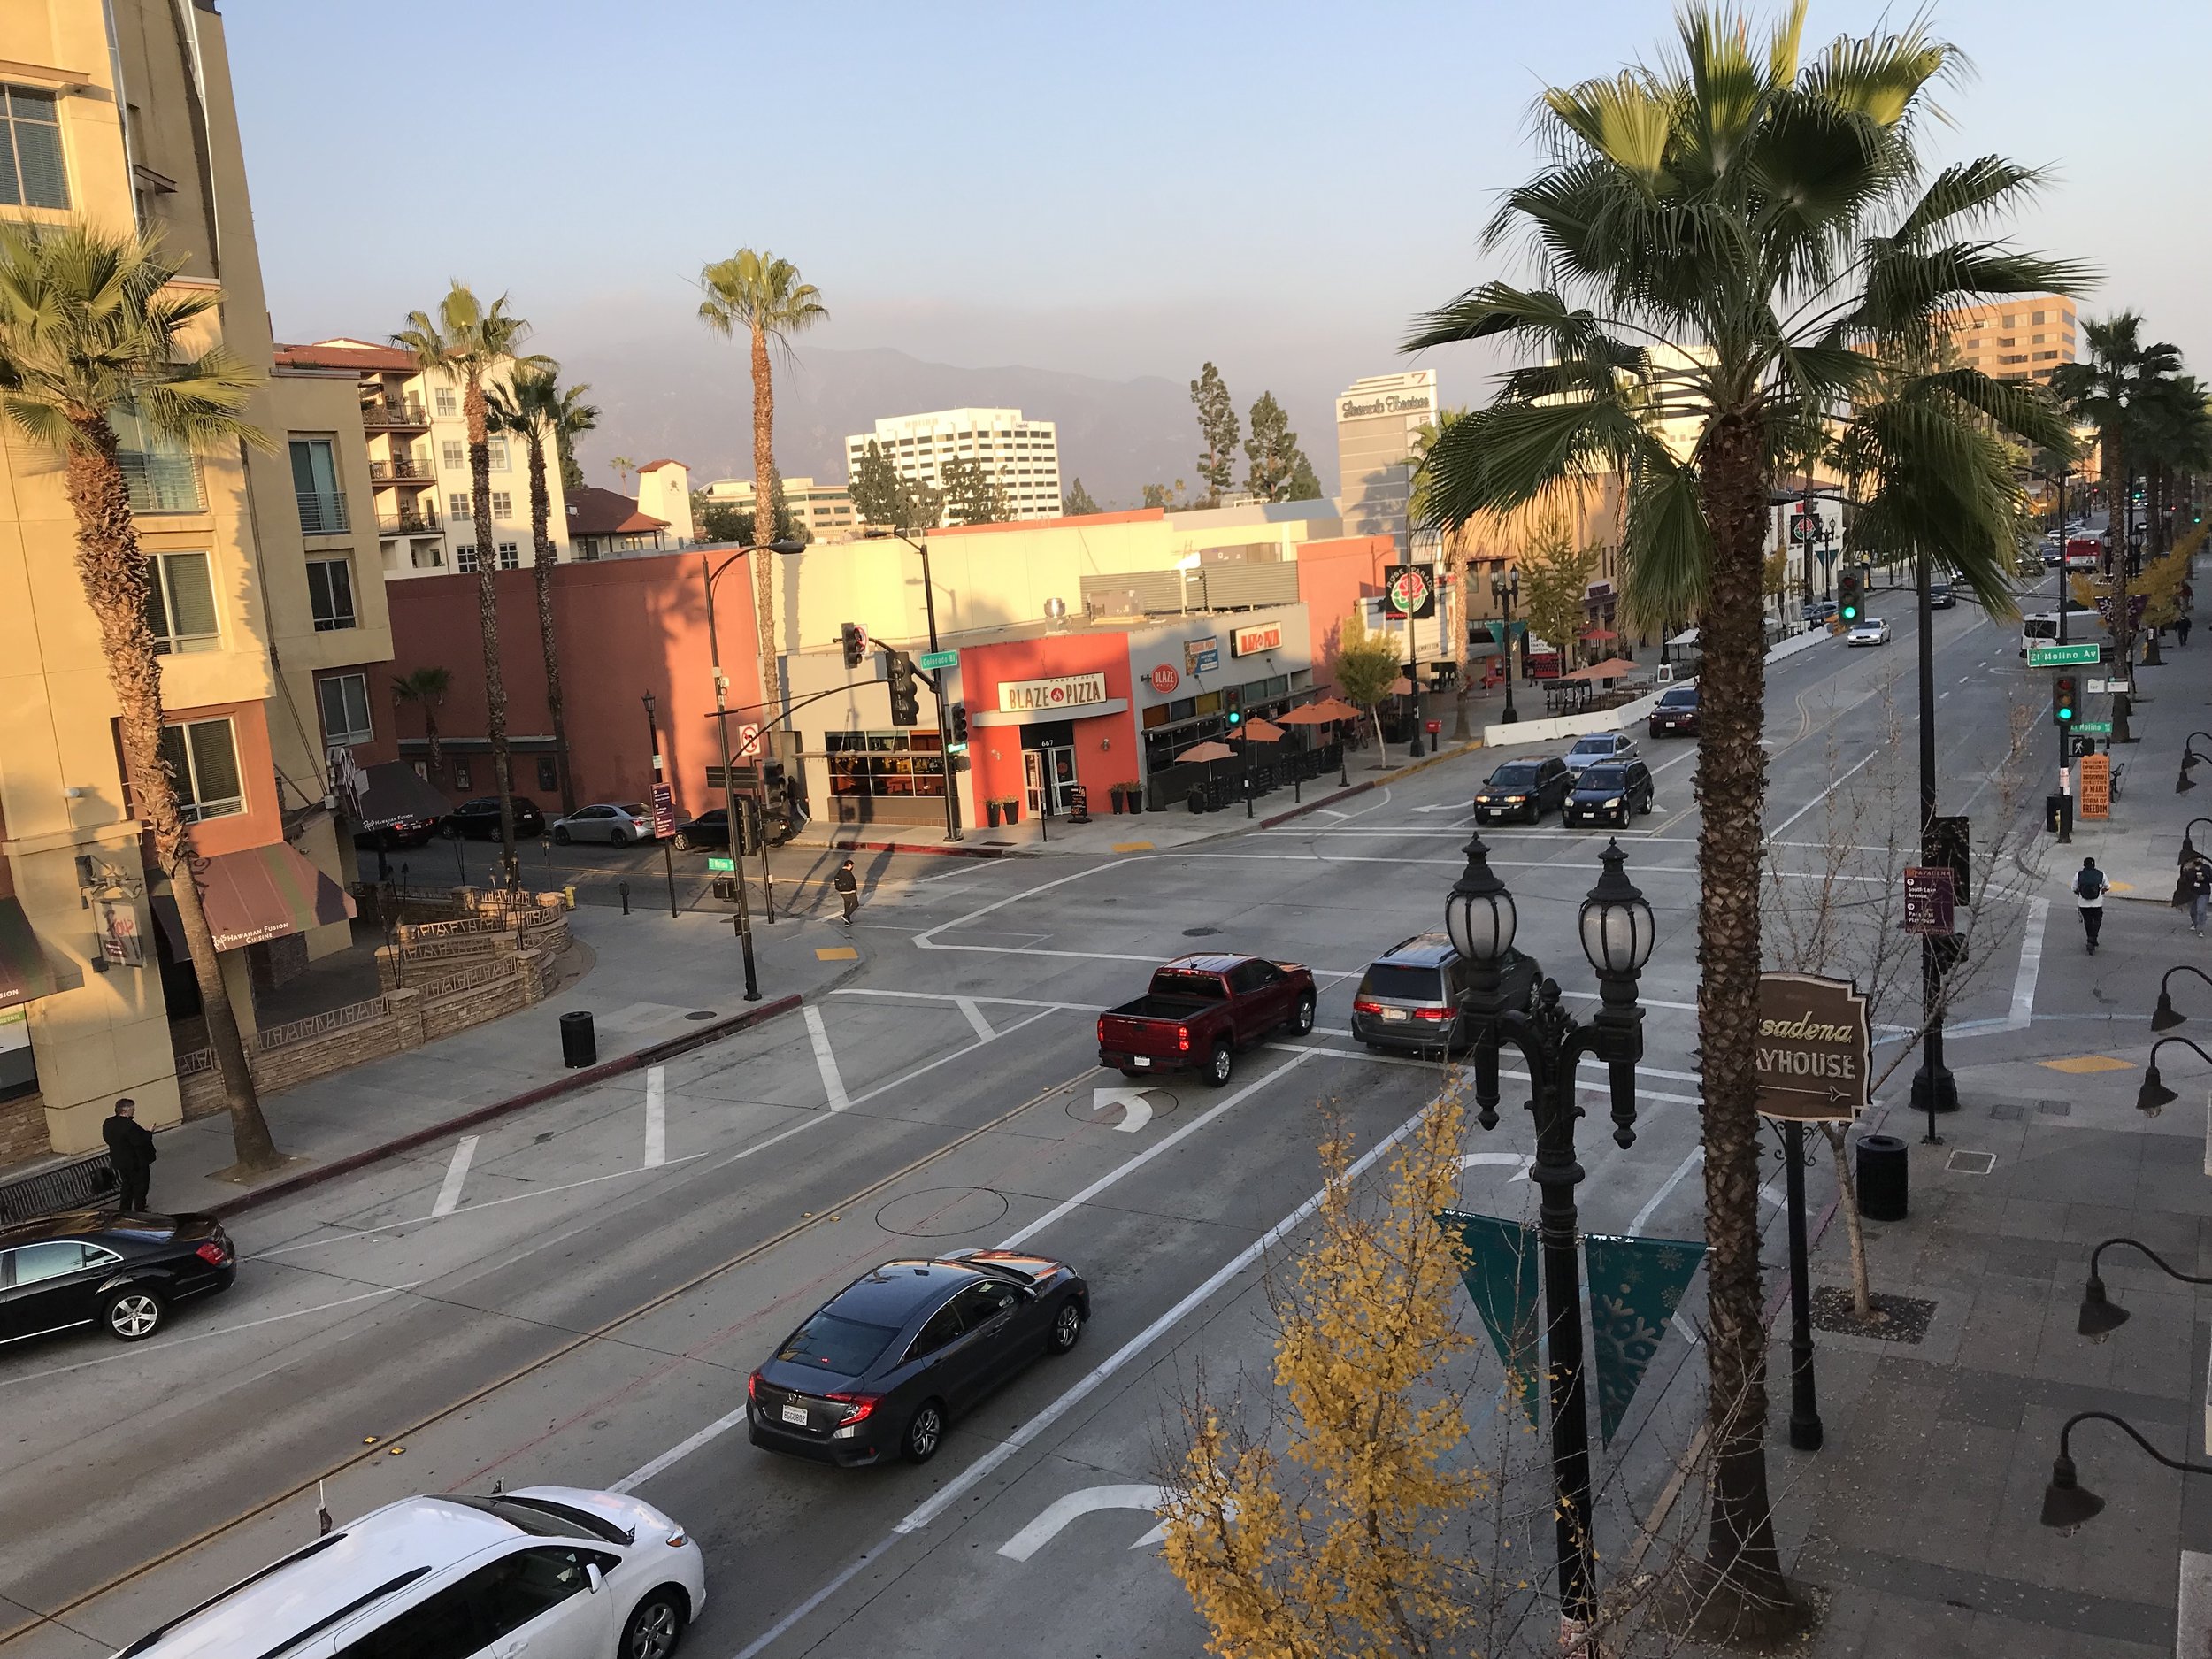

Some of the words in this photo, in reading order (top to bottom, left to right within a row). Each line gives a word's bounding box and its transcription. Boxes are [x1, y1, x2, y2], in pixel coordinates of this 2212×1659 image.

[1386, 567, 1404, 588] ROSE
[923, 655, 948, 666] Colorado
[2044, 652, 2078, 661] Molino
[2084, 649, 2097, 658] Av
[1155, 671, 1175, 684] BLAZE
[1009, 687, 1050, 710] BLAZE
[1065, 680, 1102, 704] PIZZA
[2079, 722, 2101, 732] Molino
[2083, 804, 2108, 814] FREEDOM
[227, 928, 262, 942] HAWAIIAN
[264, 922, 289, 933] FUSION
[245, 932, 273, 944] CUISINE
[1759, 1010, 1853, 1043] sadena
